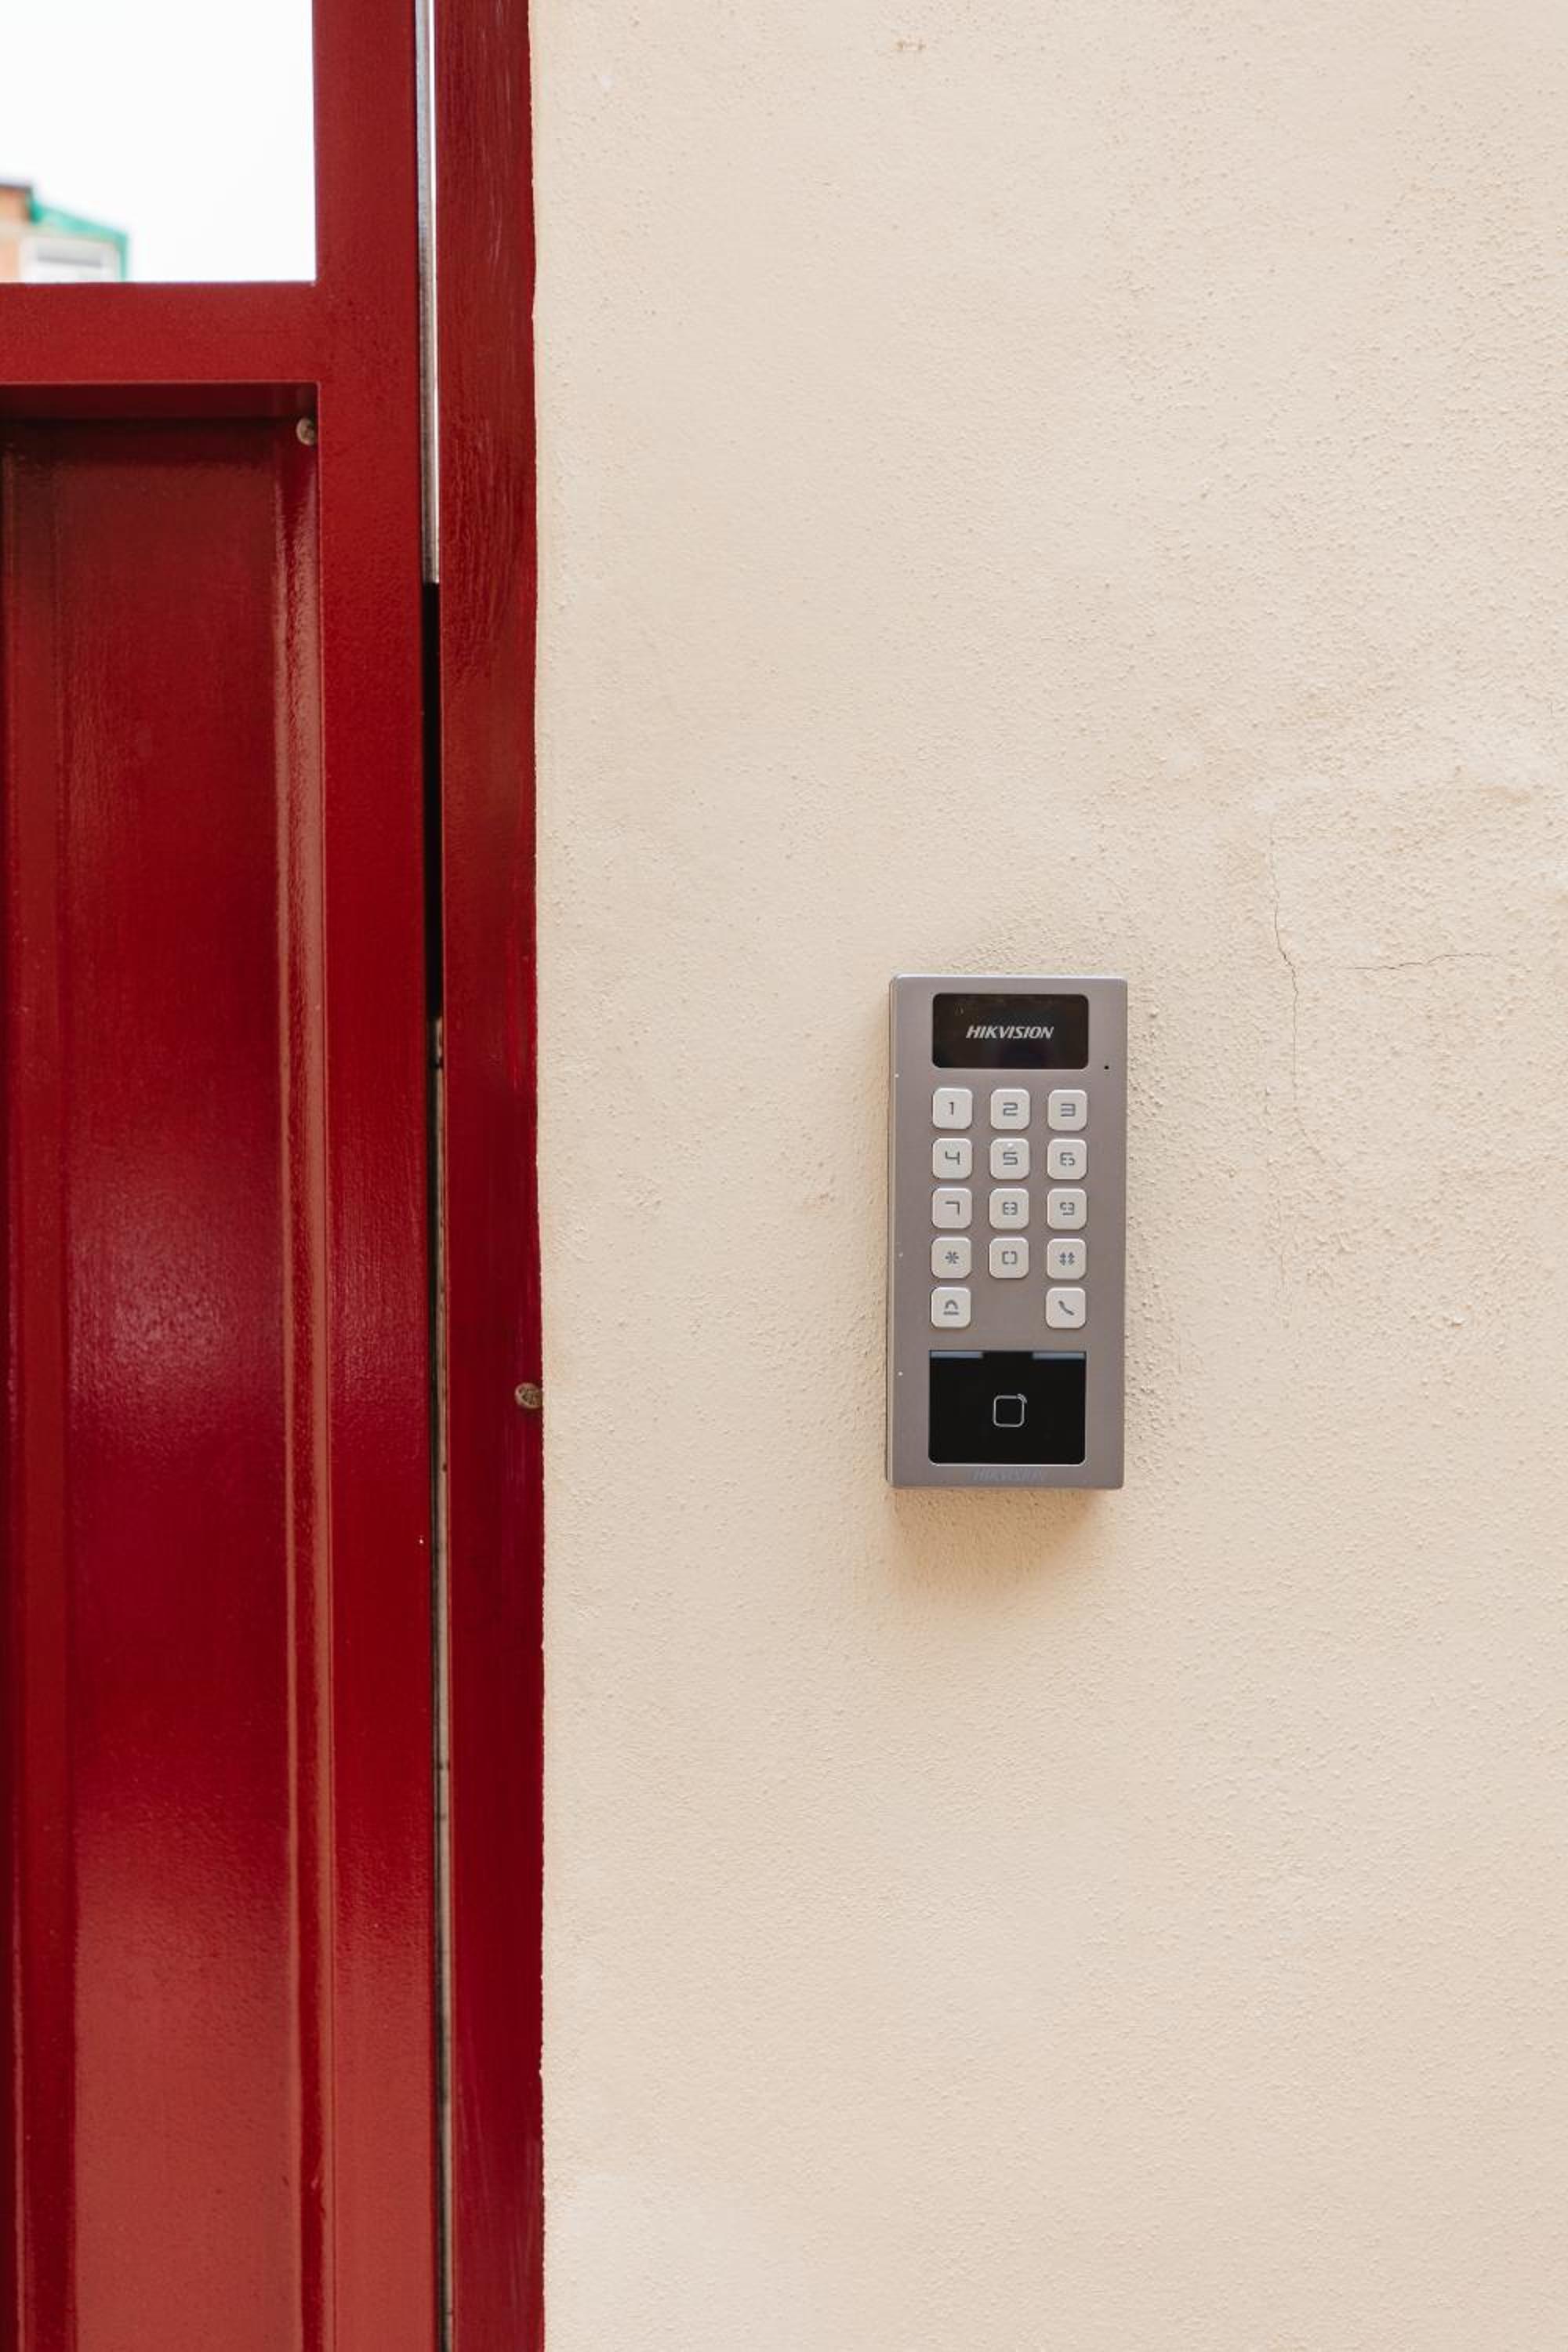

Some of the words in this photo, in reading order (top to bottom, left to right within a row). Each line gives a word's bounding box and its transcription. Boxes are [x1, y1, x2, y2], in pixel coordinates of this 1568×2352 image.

[966, 1025, 1054, 1040] HIKVISION
[947, 1101, 955, 1116] 1
[1003, 1102, 1018, 1117] 2
[1060, 1102, 1076, 1117] 3
[944, 1150, 961, 1166] 4
[1003, 1151, 1018, 1166] 5
[1060, 1152, 1076, 1167] 6
[945, 1200, 961, 1215] 7
[1002, 1202, 1018, 1216] 8
[1060, 1202, 1076, 1216] 9
